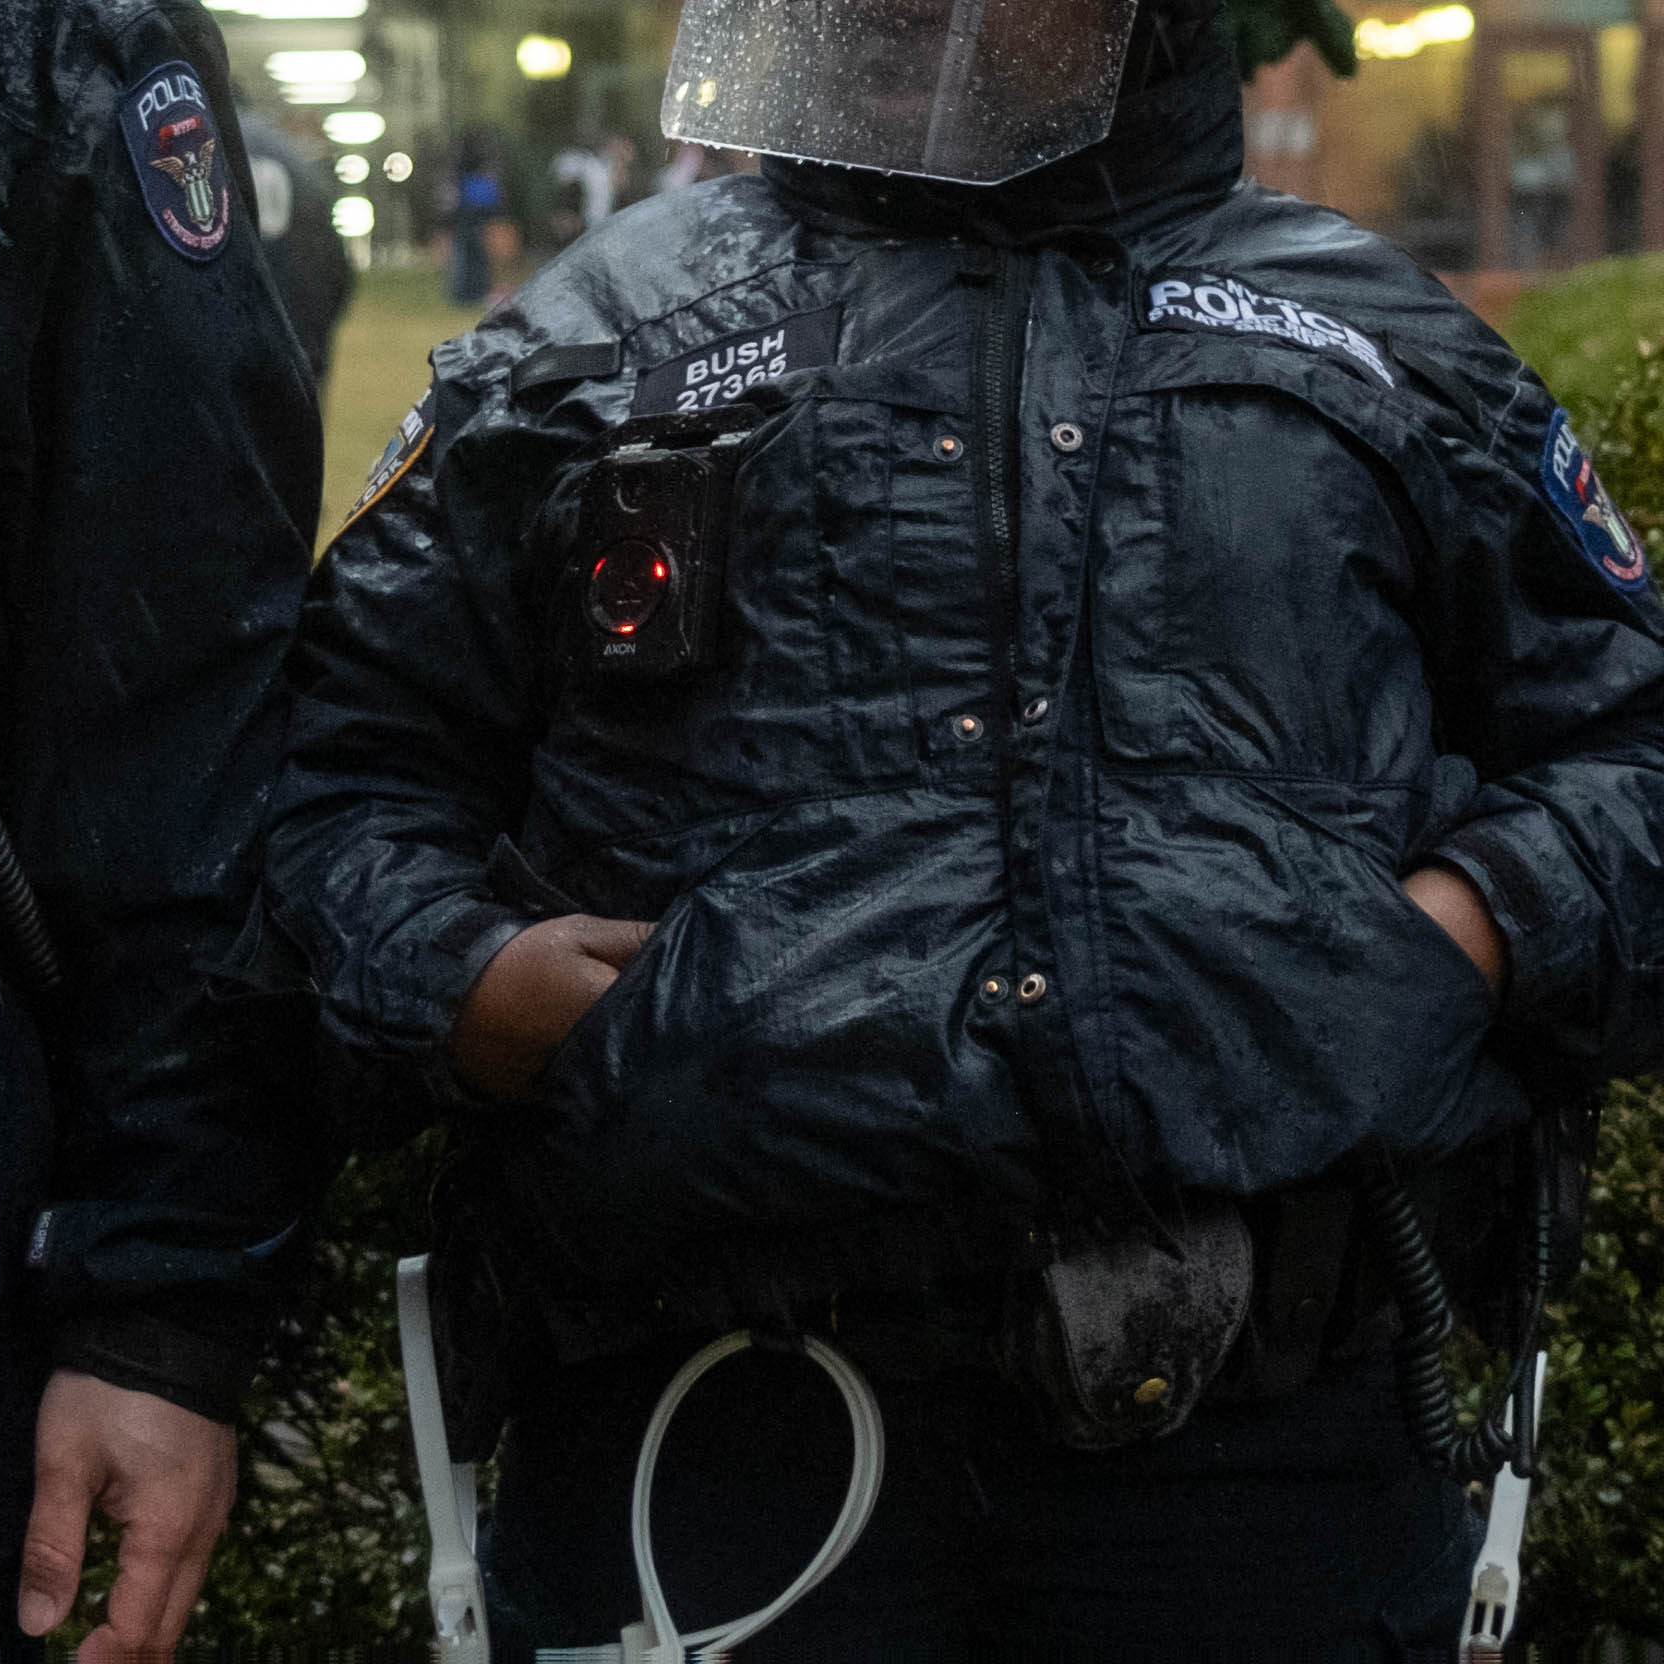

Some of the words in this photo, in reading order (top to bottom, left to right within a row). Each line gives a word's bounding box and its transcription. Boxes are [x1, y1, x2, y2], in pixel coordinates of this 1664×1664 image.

[138, 75, 206, 131] POLICE
[1148, 279, 1384, 366] POLICE
[677, 353, 787, 411] 27365
[686, 329, 785, 387] BUSH
[603, 643, 636, 656] AXON
